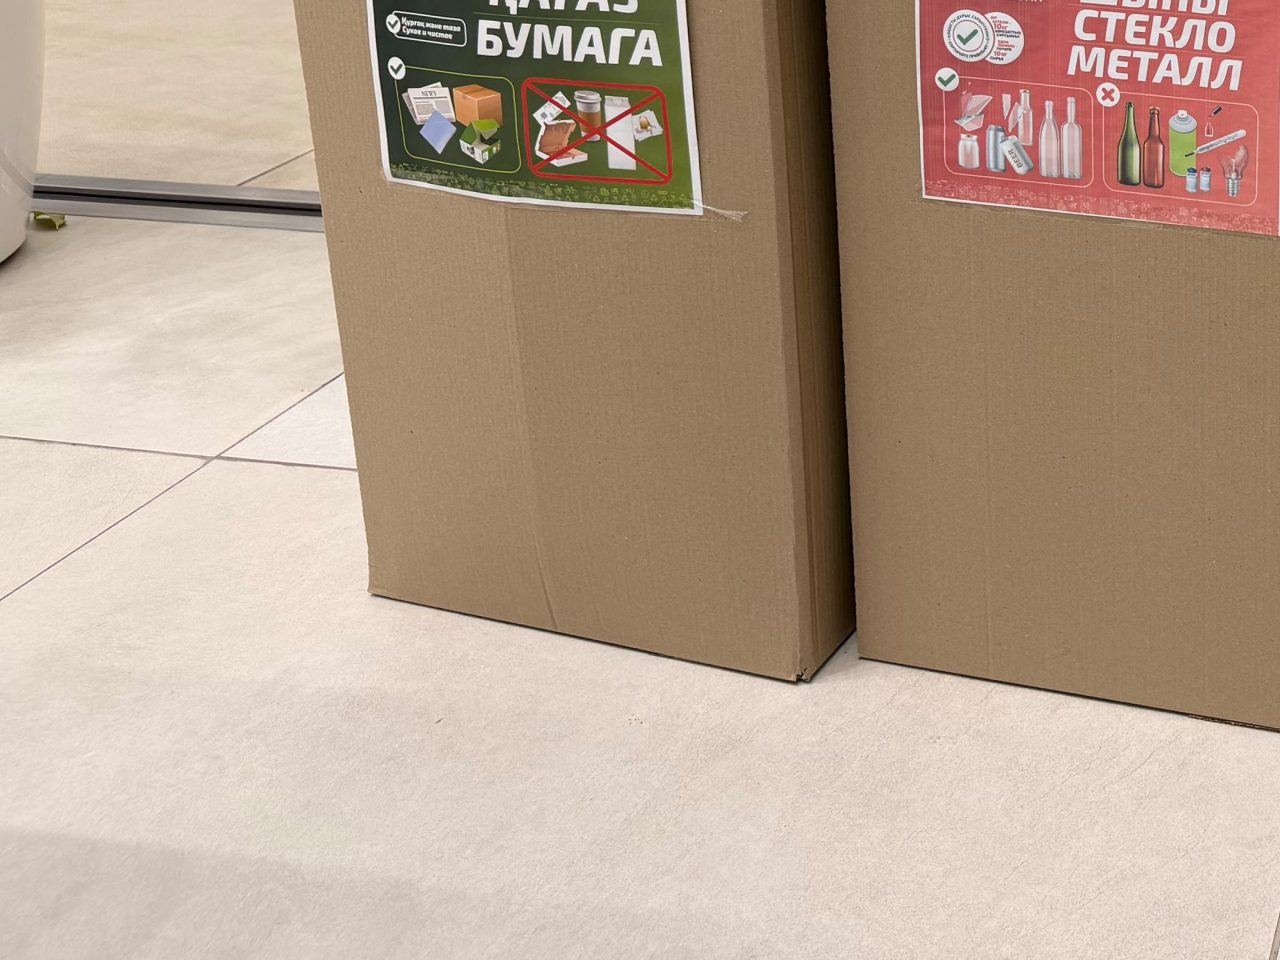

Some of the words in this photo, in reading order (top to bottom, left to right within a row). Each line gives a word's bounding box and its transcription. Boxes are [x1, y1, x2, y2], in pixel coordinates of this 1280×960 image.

[477, 19, 663, 67] БУМАГА
[1074, 9, 1236, 53] СТЕКЛО
[1067, 45, 1244, 91] МЕТАЛЛ
